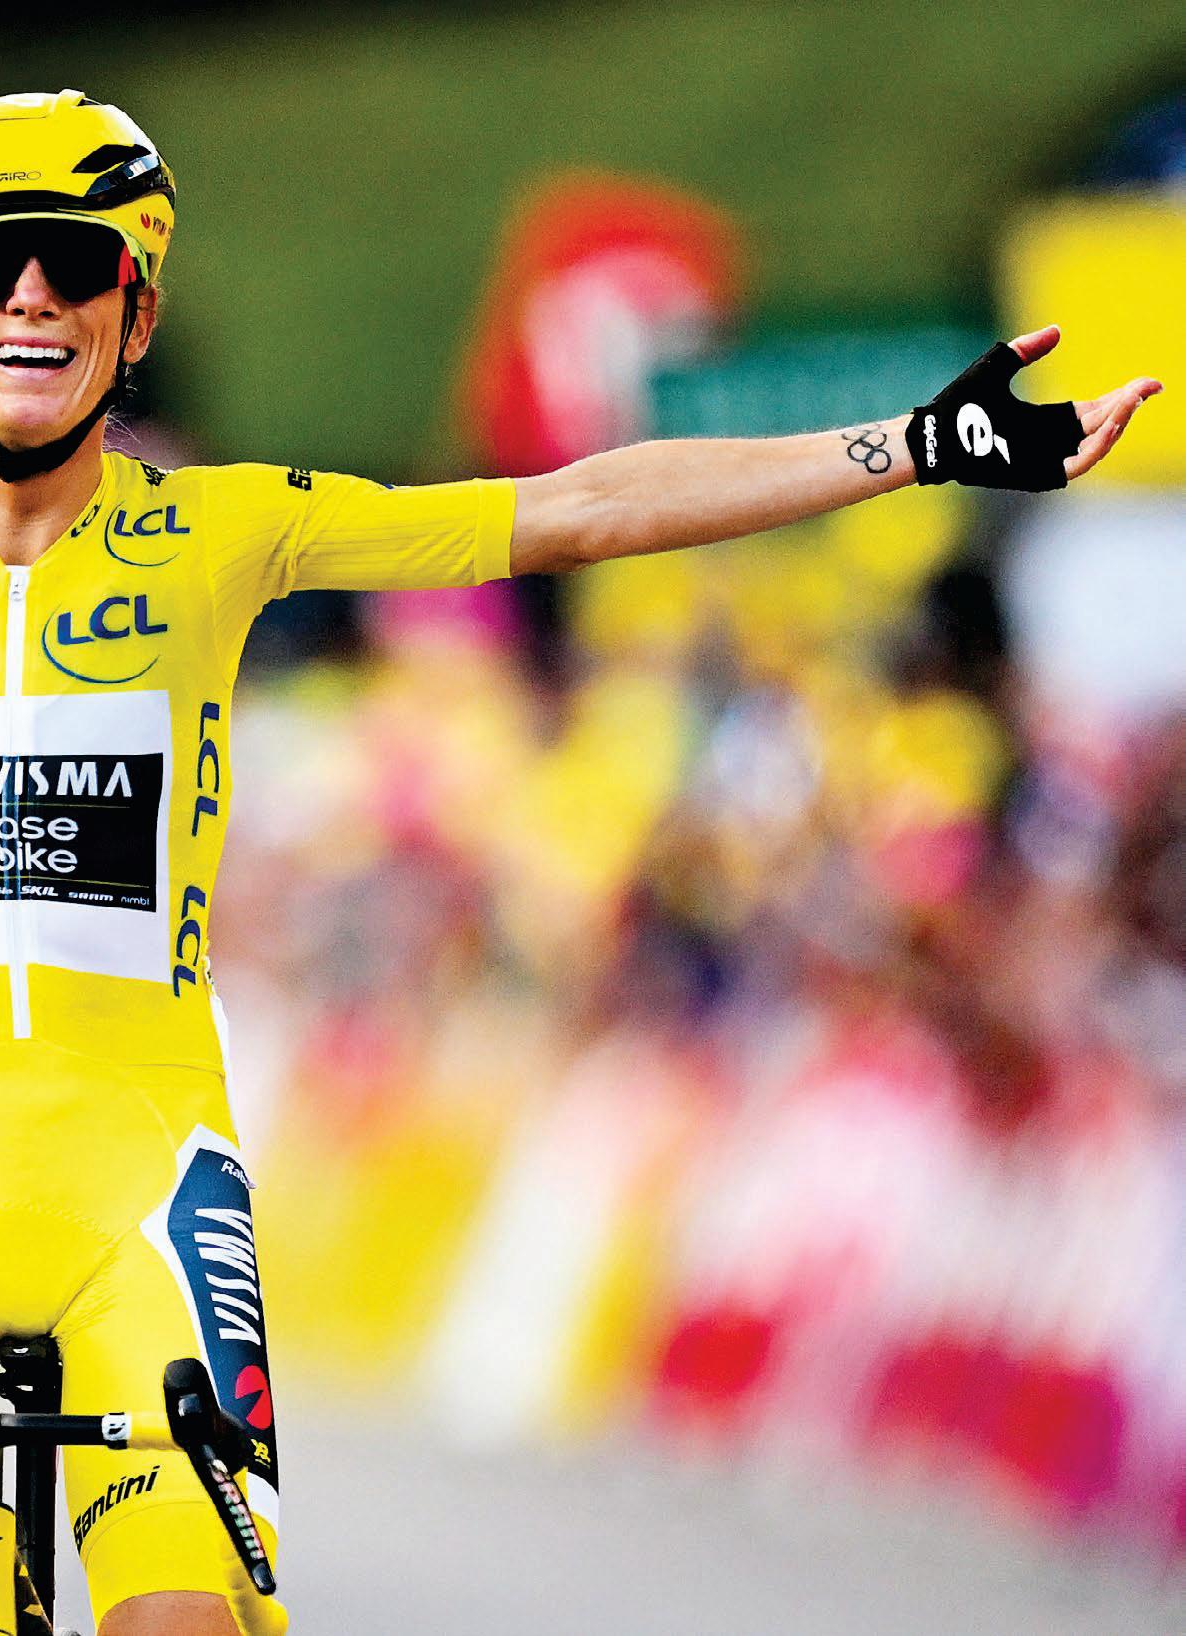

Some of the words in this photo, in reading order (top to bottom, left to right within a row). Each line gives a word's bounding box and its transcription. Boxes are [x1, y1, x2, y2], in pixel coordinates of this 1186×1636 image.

[114, 505, 190, 537] LCL
[57, 594, 168, 645] LCL
[192, 701, 220, 838] LCL
[19, 885, 59, 896] SKIL
[173, 886, 206, 998] LCL
[193, 1208, 261, 1345] VISMA
[73, 1465, 160, 1553] Santini
